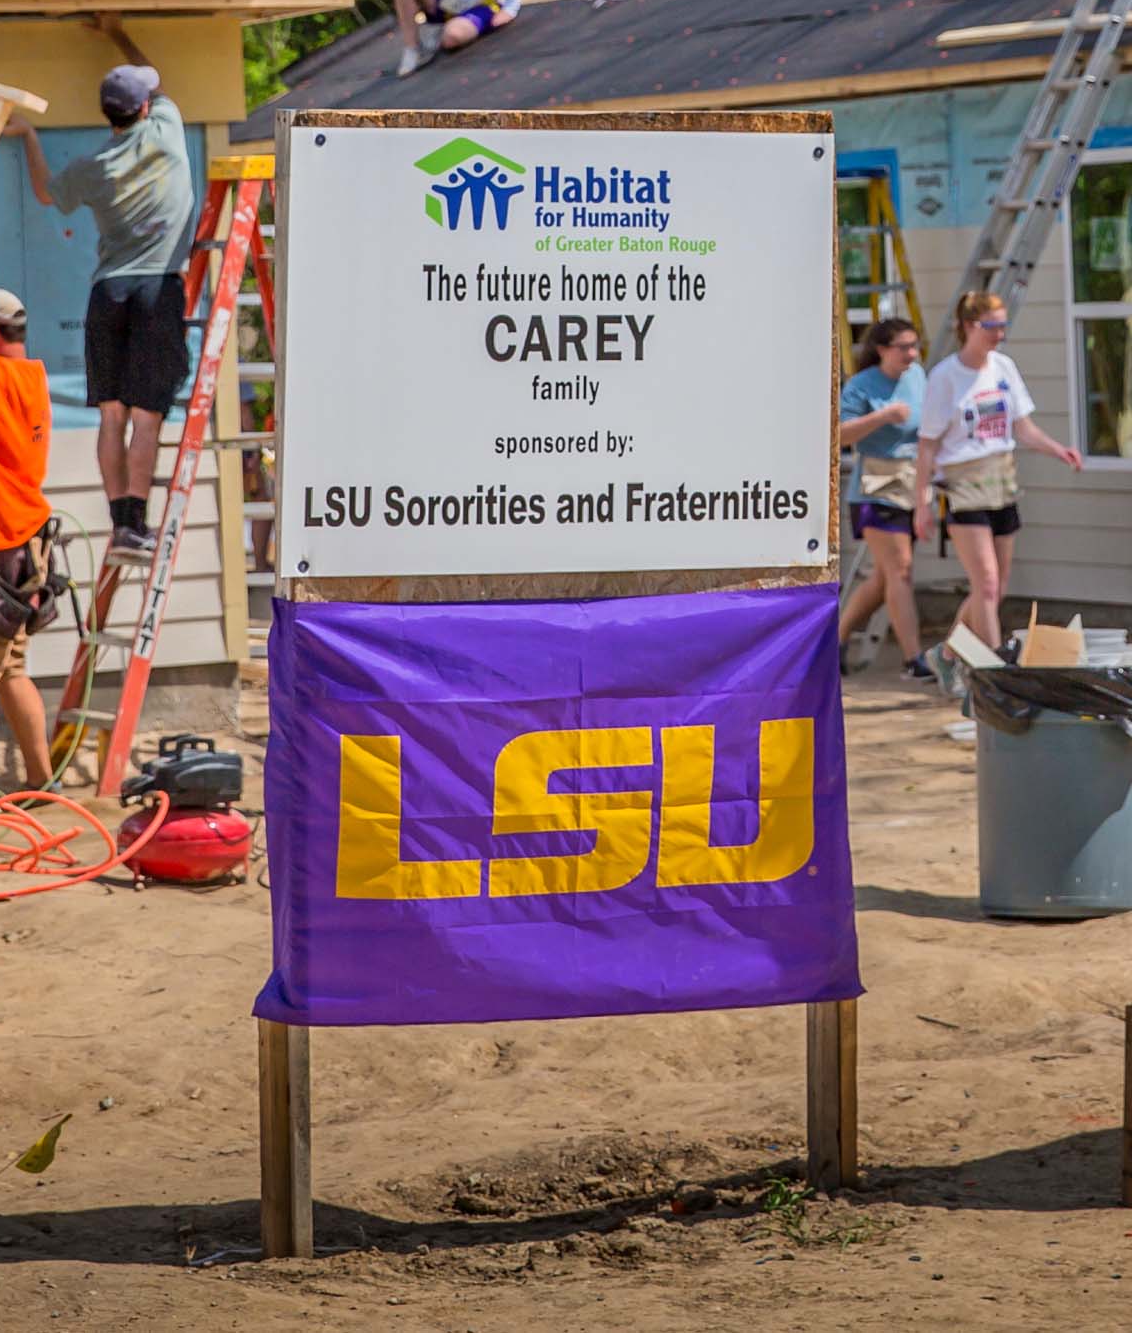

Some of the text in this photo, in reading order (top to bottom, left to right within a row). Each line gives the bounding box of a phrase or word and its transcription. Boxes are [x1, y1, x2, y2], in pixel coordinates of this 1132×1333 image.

[534, 166, 670, 204] Habitat
[535, 207, 670, 233] for Humanity
[535, 236, 717, 255] of Greater Baton Rouge
[422, 262, 706, 302] The future home of the
[485, 314, 655, 363] CAREY
[531, 374, 600, 405] family
[494, 430, 633, 459] sponsored by:
[304, 480, 809, 528] LSU Sororities and Fraternities
[335, 717, 814, 899] LSU
